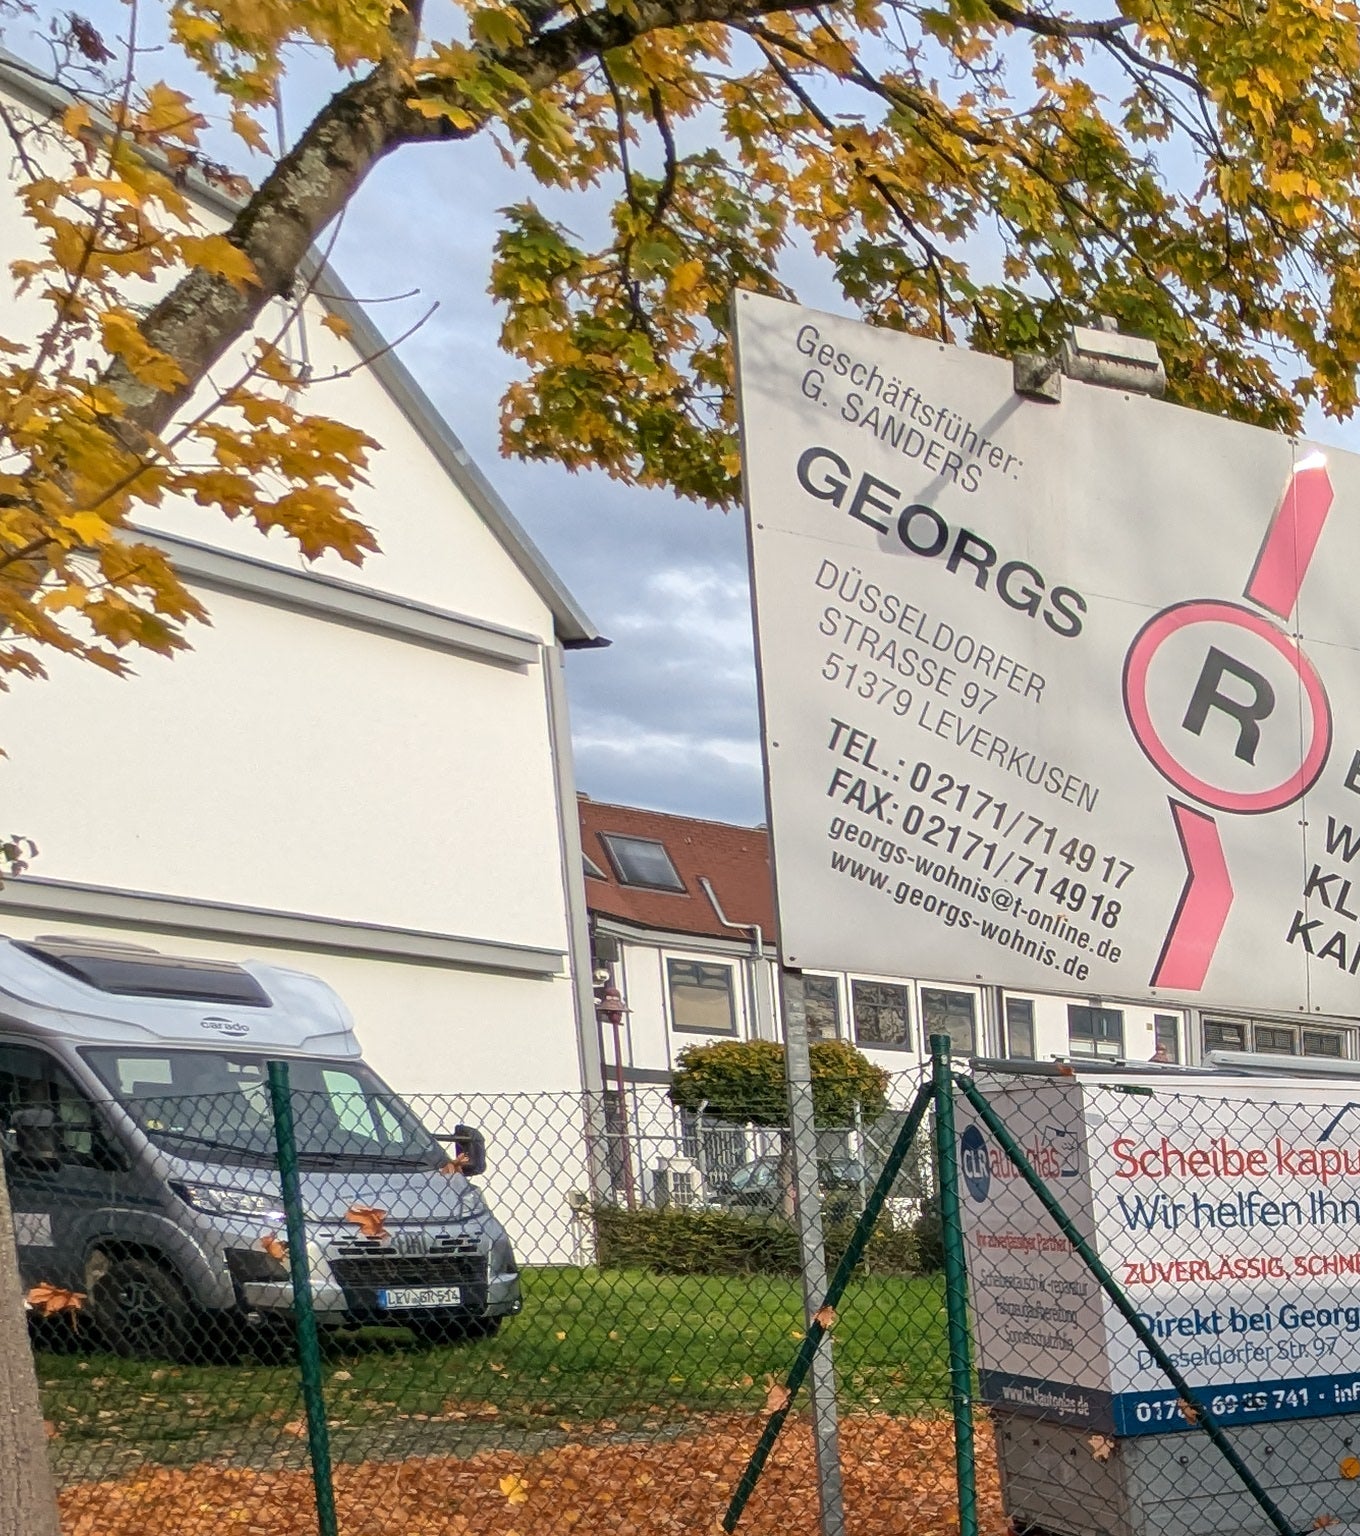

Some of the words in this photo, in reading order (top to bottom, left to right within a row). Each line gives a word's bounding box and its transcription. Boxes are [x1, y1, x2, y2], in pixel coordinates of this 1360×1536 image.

[796, 324, 1023, 480] Geschäftsführer:
[801, 369, 828, 408] G.
[841, 393, 984, 493] SANDERS
[796, 446, 1088, 638] GEORGS
[815, 559, 1046, 703] DÜSSELDORFER
[819, 607, 956, 697] STRASSE
[960, 681, 998, 715] 97
[822, 652, 913, 717] 51379
[918, 701, 1100, 812] LEVERKUSEN
[826, 717, 905, 782] TEL.:
[1181, 646, 1277, 767] R
[826, 768, 899, 824] FAX:
[828, 816, 1122, 963] georgs-wohnis@t-online.de
[831, 850, 1089, 981] www.georgs-wohnis.de
[963, 1149, 988, 1178] CLR
[1112, 1137, 1268, 1178] Scheibe
[1117, 1193, 1186, 1230] Wir
[1192, 1190, 1302, 1228] helfen
[1123, 1254, 1291, 1285] ZUVERLÄSSIG,
[1138, 1341, 1273, 1371] Dsseldorfer
[1277, 1339, 1309, 1360] Str.
[1313, 1336, 1338, 1358] 97
[1229, 1303, 1272, 1333] bei
[1272, 1388, 1309, 1409] 741
